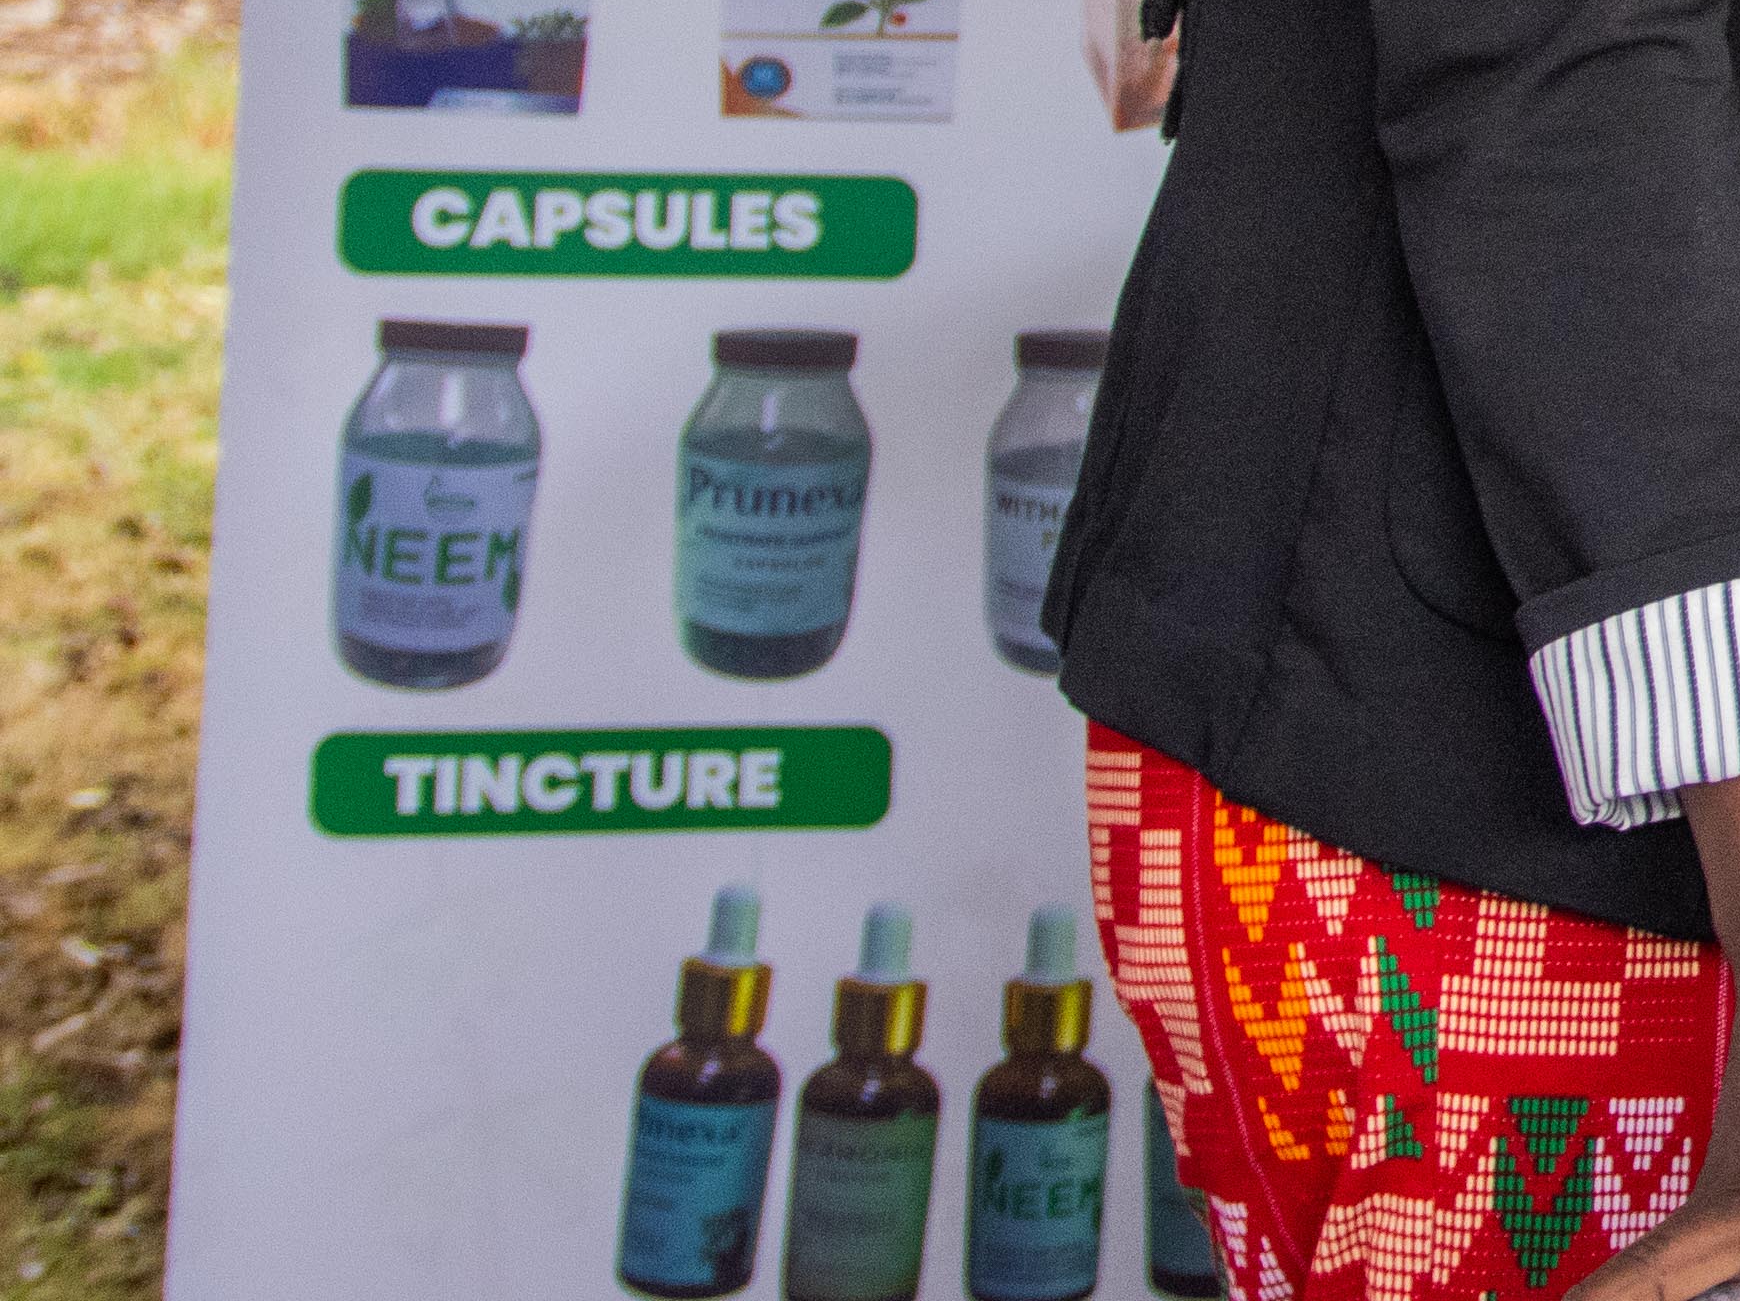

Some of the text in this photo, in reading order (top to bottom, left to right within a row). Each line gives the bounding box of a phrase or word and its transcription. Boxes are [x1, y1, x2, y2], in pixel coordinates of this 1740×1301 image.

[411, 187, 823, 250] CAPSULES
[343, 526, 520, 585] NEEM
[384, 749, 783, 816] TINCTURE
